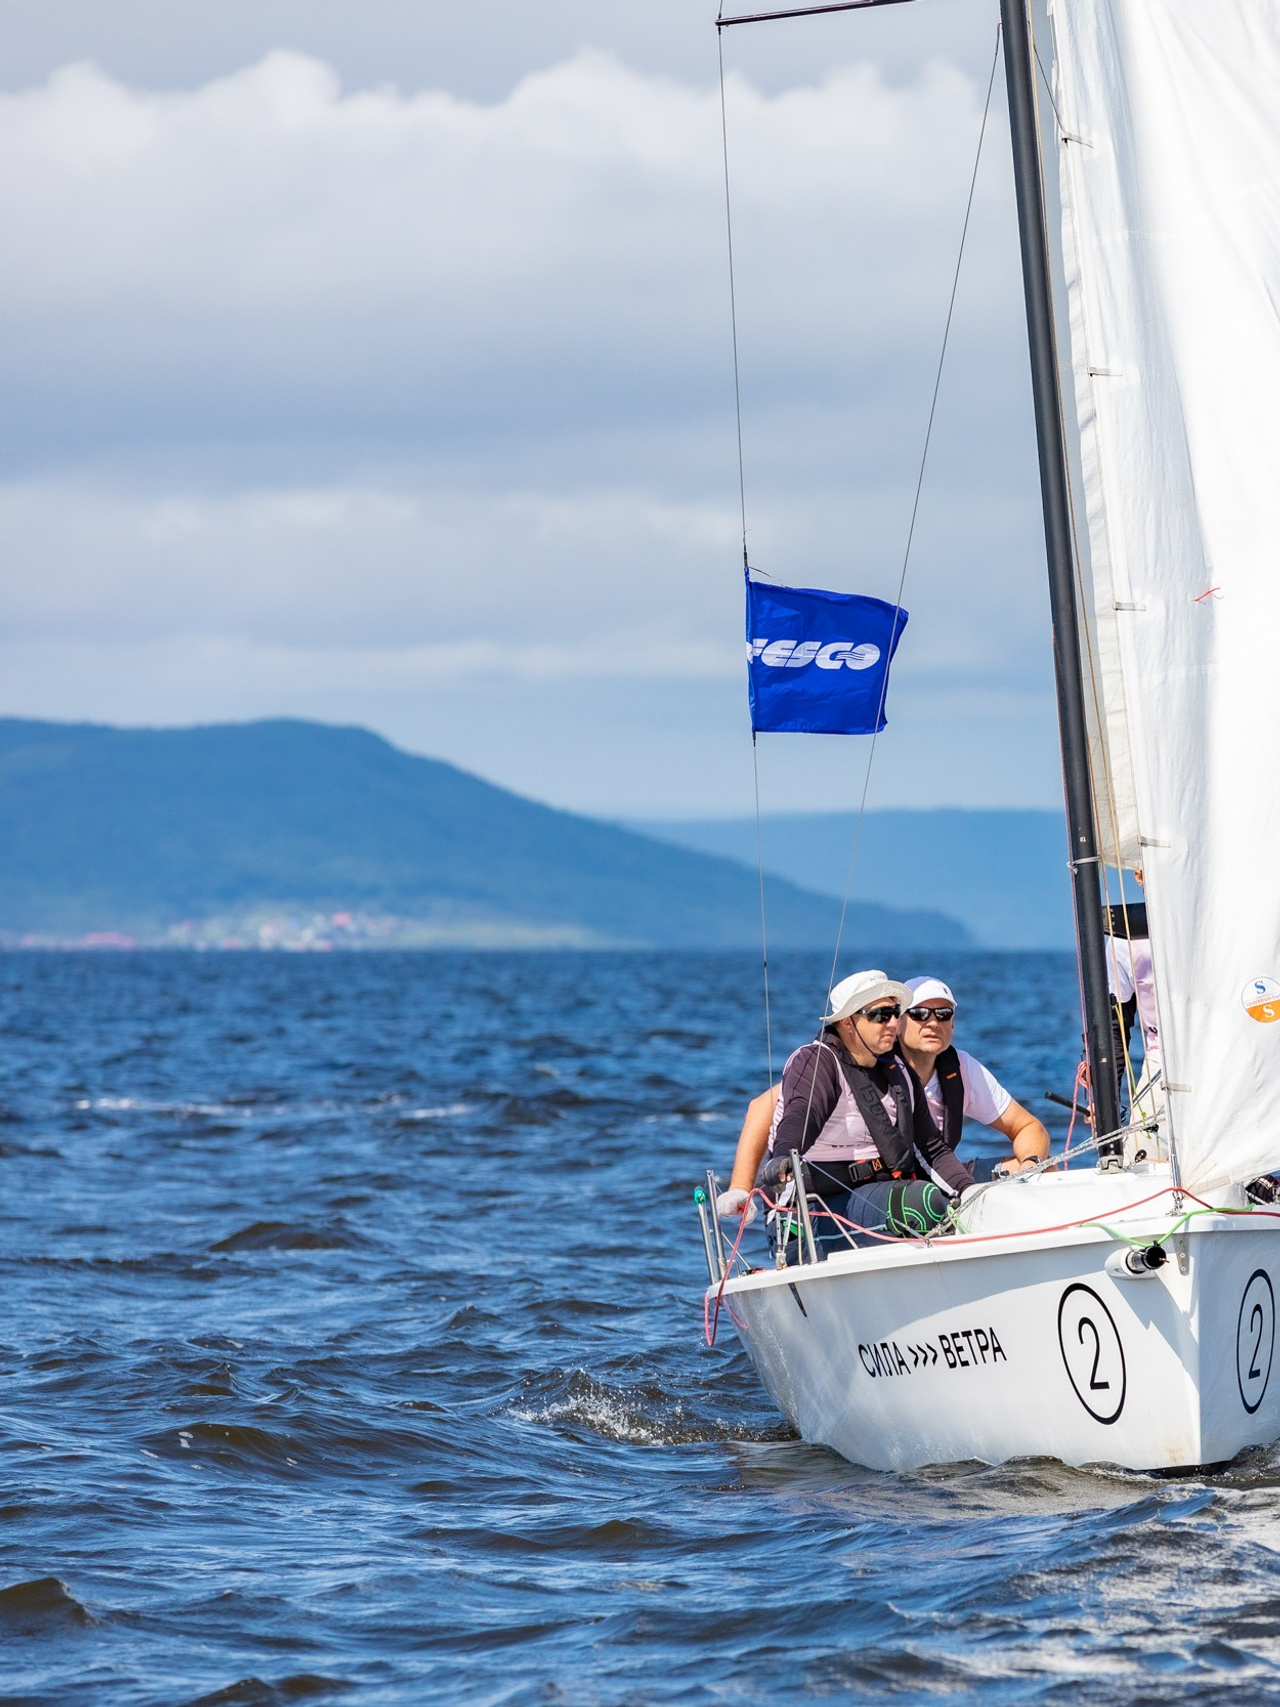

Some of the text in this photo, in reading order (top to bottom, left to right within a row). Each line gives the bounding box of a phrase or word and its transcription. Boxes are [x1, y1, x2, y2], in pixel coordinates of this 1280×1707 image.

[1254, 980, 1266, 995] S
[1262, 1004, 1275, 1019] S
[858, 1327, 1007, 1378] СИЛА ВЕТРА
[1078, 1317, 1110, 1390] 2
[1249, 1304, 1263, 1380] 2
